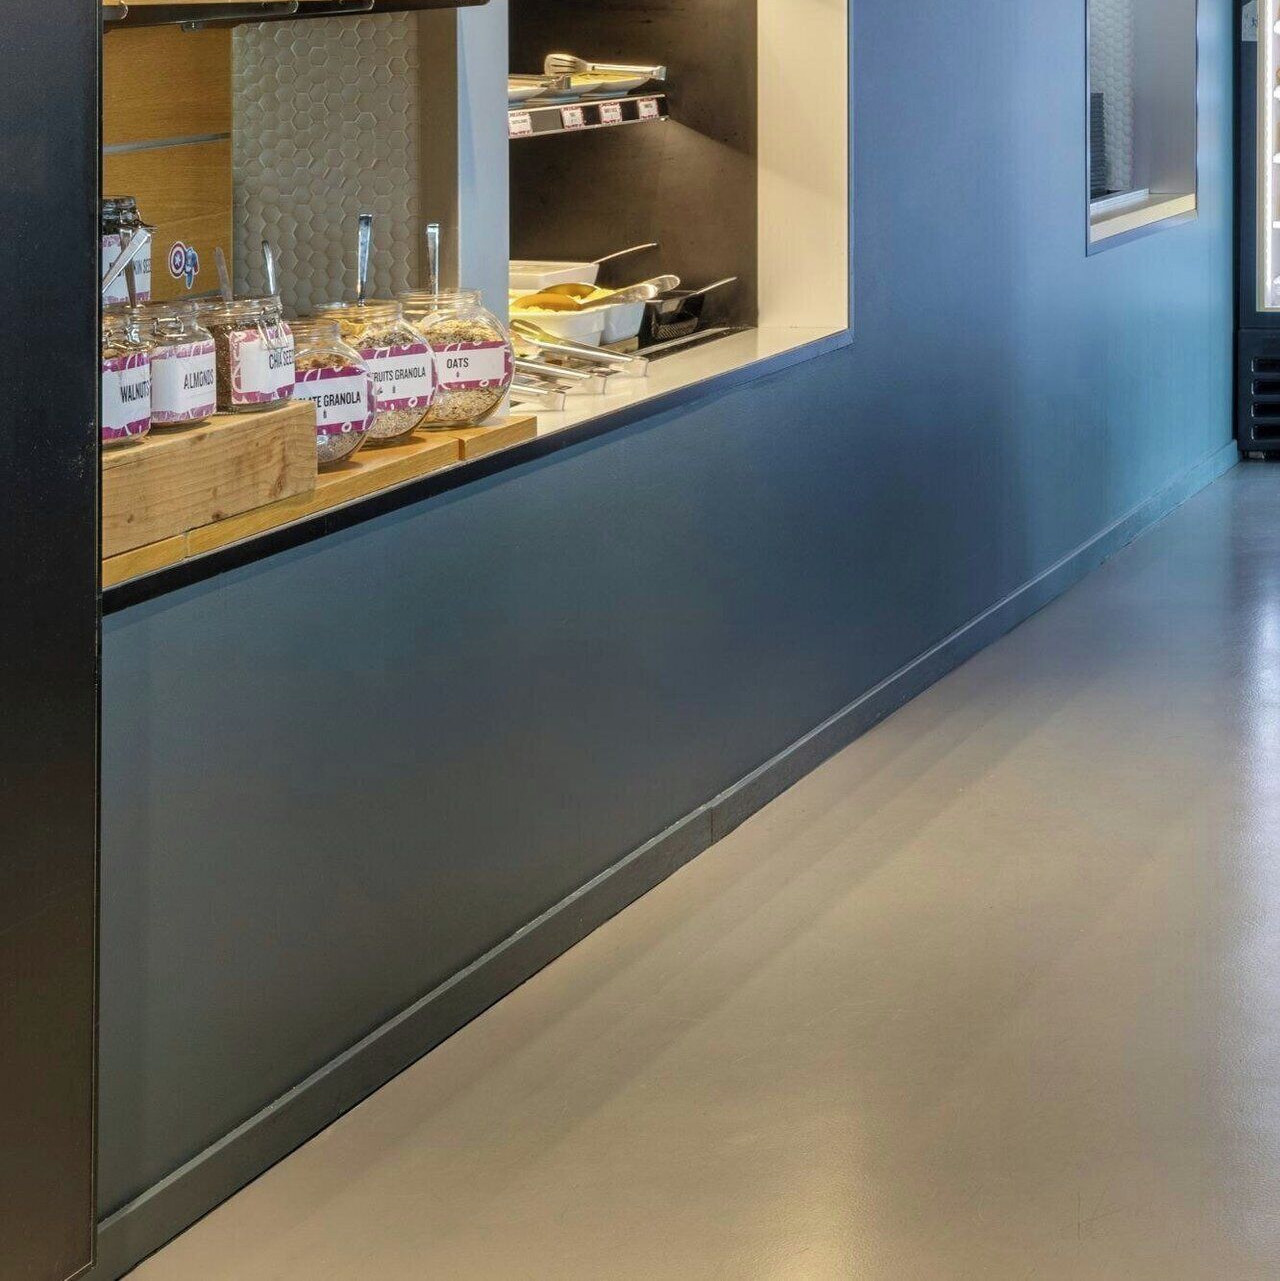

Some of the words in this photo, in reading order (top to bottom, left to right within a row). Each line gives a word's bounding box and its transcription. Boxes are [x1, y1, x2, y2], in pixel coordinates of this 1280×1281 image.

[446, 358, 469, 369] OATS
[183, 369, 215, 390] ALMONDS
[394, 367, 426, 380] GRANOLA
[323, 391, 362, 408] GRANOLA
